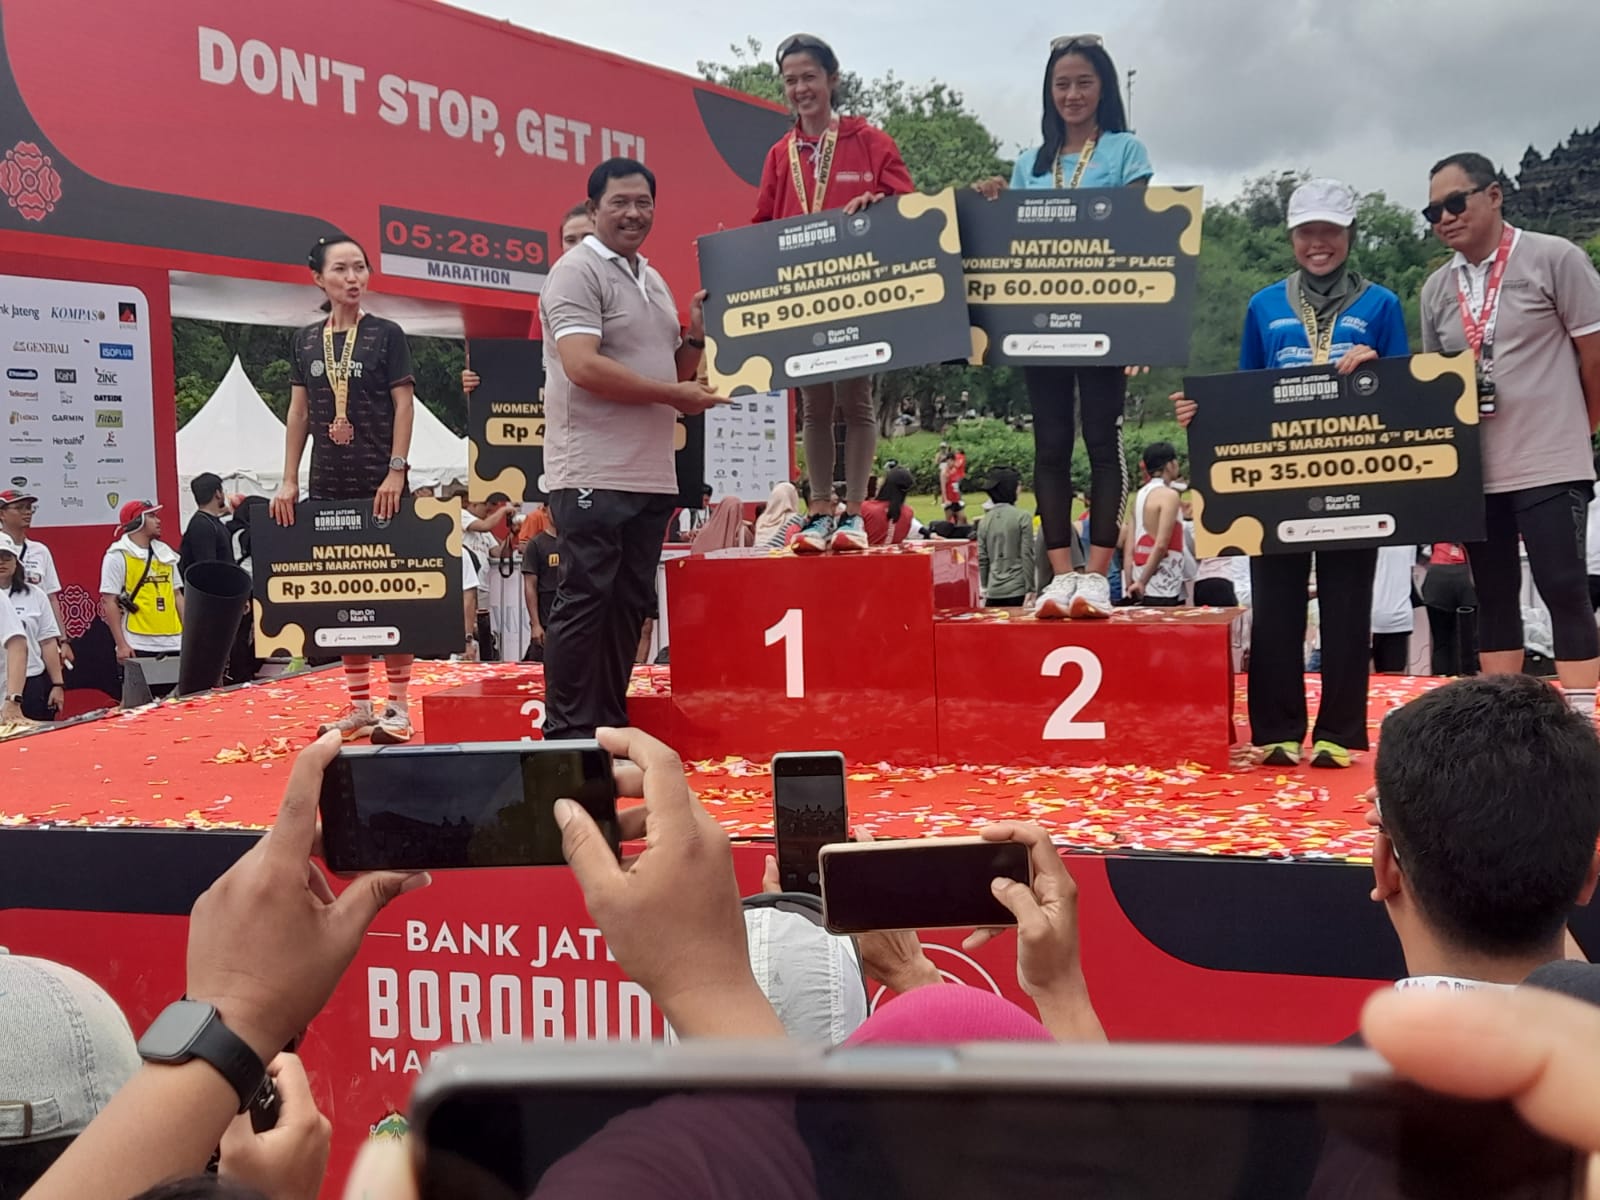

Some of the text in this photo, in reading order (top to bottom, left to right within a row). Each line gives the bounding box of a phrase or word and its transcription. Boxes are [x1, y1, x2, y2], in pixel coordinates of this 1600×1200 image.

[198, 26, 365, 114] DON'T
[378, 74, 506, 158] STOP,
[516, 108, 592, 165] GET
[385, 220, 544, 264] 05:28:59
[1010, 239, 1115, 255] NATIONAL
[778, 252, 879, 283] NATIONAL
[1025, 257, 1104, 268] MARATHON
[1130, 256, 1176, 268] PLACE
[427, 262, 510, 285] MARATHON
[726, 282, 792, 304] WOMEN'S
[794, 270, 872, 294] MARATHON
[892, 258, 936, 276] PLACE
[968, 278, 1156, 300] Rp 60.000.000,-
[12, 304, 40, 320] Jateng
[51, 307, 98, 321] KOMPAS
[741, 285, 925, 330] Rp 90.000.000,-
[1069, 312, 1082, 320] On
[828, 326, 859, 337] Run On
[828, 335, 850, 344] Mark
[26, 342, 70, 354] GENERALI
[102, 348, 132, 358] ISOPLUS
[340, 342, 352, 382] PODIUM
[97, 372, 118, 384] ZINC
[52, 414, 84, 422] GARMIN
[98, 414, 121, 424] Fitbar
[1271, 414, 1386, 438] NATIONAL
[502, 423, 529, 442] Rp
[1214, 440, 1287, 456] WOMEN'S
[1290, 434, 1376, 450] MARATHON
[1404, 428, 1454, 442] PLACE
[1231, 454, 1434, 487] Rp 35.000.000,-
[1326, 494, 1360, 504] Run On
[1326, 502, 1350, 510] Mark
[312, 544, 396, 560] NATIONAL
[271, 560, 324, 572] WOMEN'S
[325, 559, 388, 571] MARATHON
[407, 558, 444, 568] PLACE
[282, 578, 430, 600] Rp 30.000.000,-
[764, 608, 804, 698] 1
[1040, 646, 1106, 740] 2
[406, 920, 617, 968] BANK JAT
[367, 967, 669, 1047] BOROBUD
